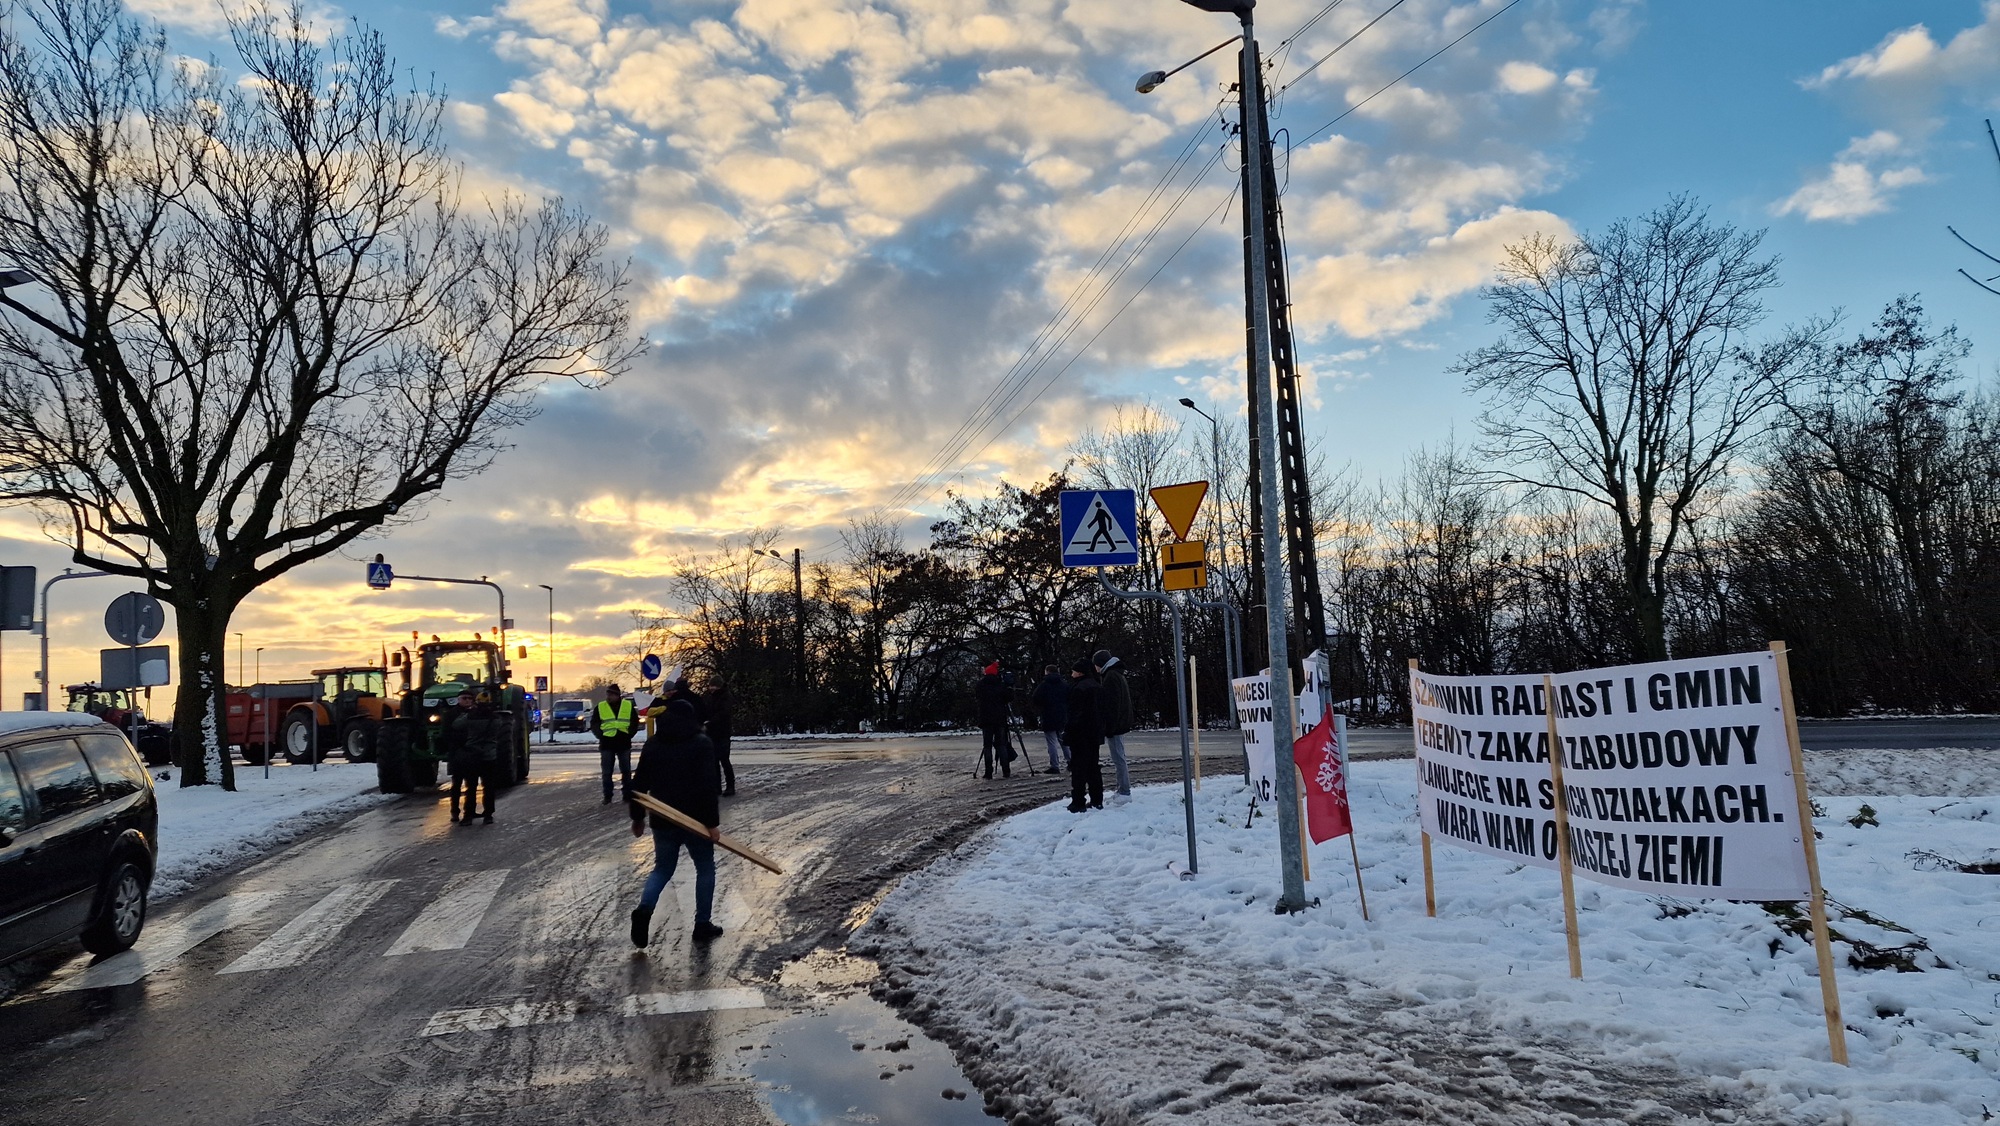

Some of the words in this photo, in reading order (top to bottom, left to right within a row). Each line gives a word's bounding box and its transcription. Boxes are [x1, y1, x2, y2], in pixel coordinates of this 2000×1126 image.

[1625, 677, 1638, 713] I
[1648, 665, 1762, 711] GMIN
[1461, 730, 1476, 760] Z
[1565, 725, 1761, 770] ZABUDOWY
[1419, 757, 1494, 804] PLANUJECIE
[1496, 776, 1532, 808] NA
[1591, 785, 1784, 823] DZIAŁKACH.
[1437, 798, 1482, 845] WARA
[1482, 811, 1536, 857] WAM
[1570, 826, 1632, 879] NASZEJ
[1635, 834, 1724, 887] ZIEMI
